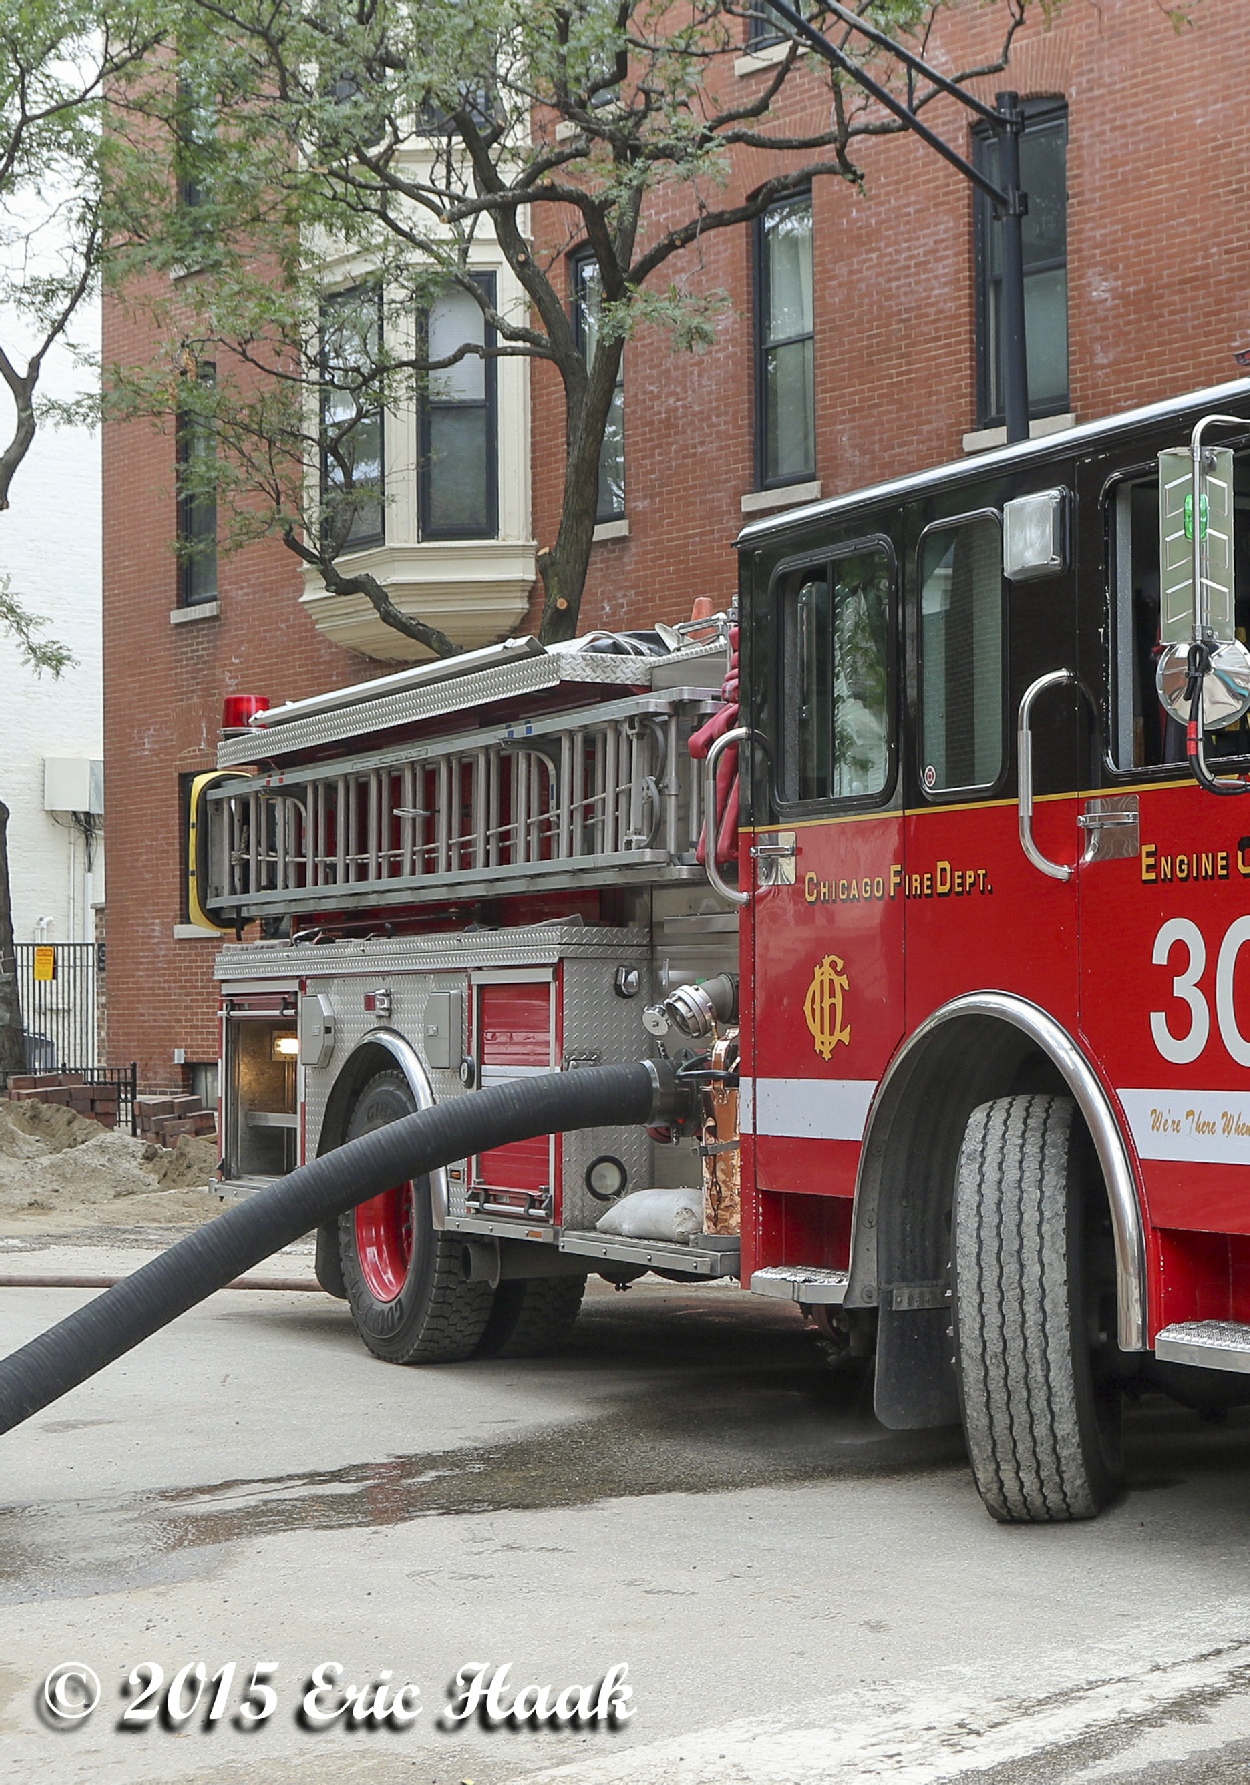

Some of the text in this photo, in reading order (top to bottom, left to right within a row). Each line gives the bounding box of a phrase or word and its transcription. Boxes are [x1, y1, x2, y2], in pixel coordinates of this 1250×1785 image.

[804, 860, 993, 905] CHICAGO FIRE DEPT.
[1141, 843, 1229, 884] ENGINE
[1150, 1108, 1182, 1133] We're
[1185, 1109, 1217, 1136] There
